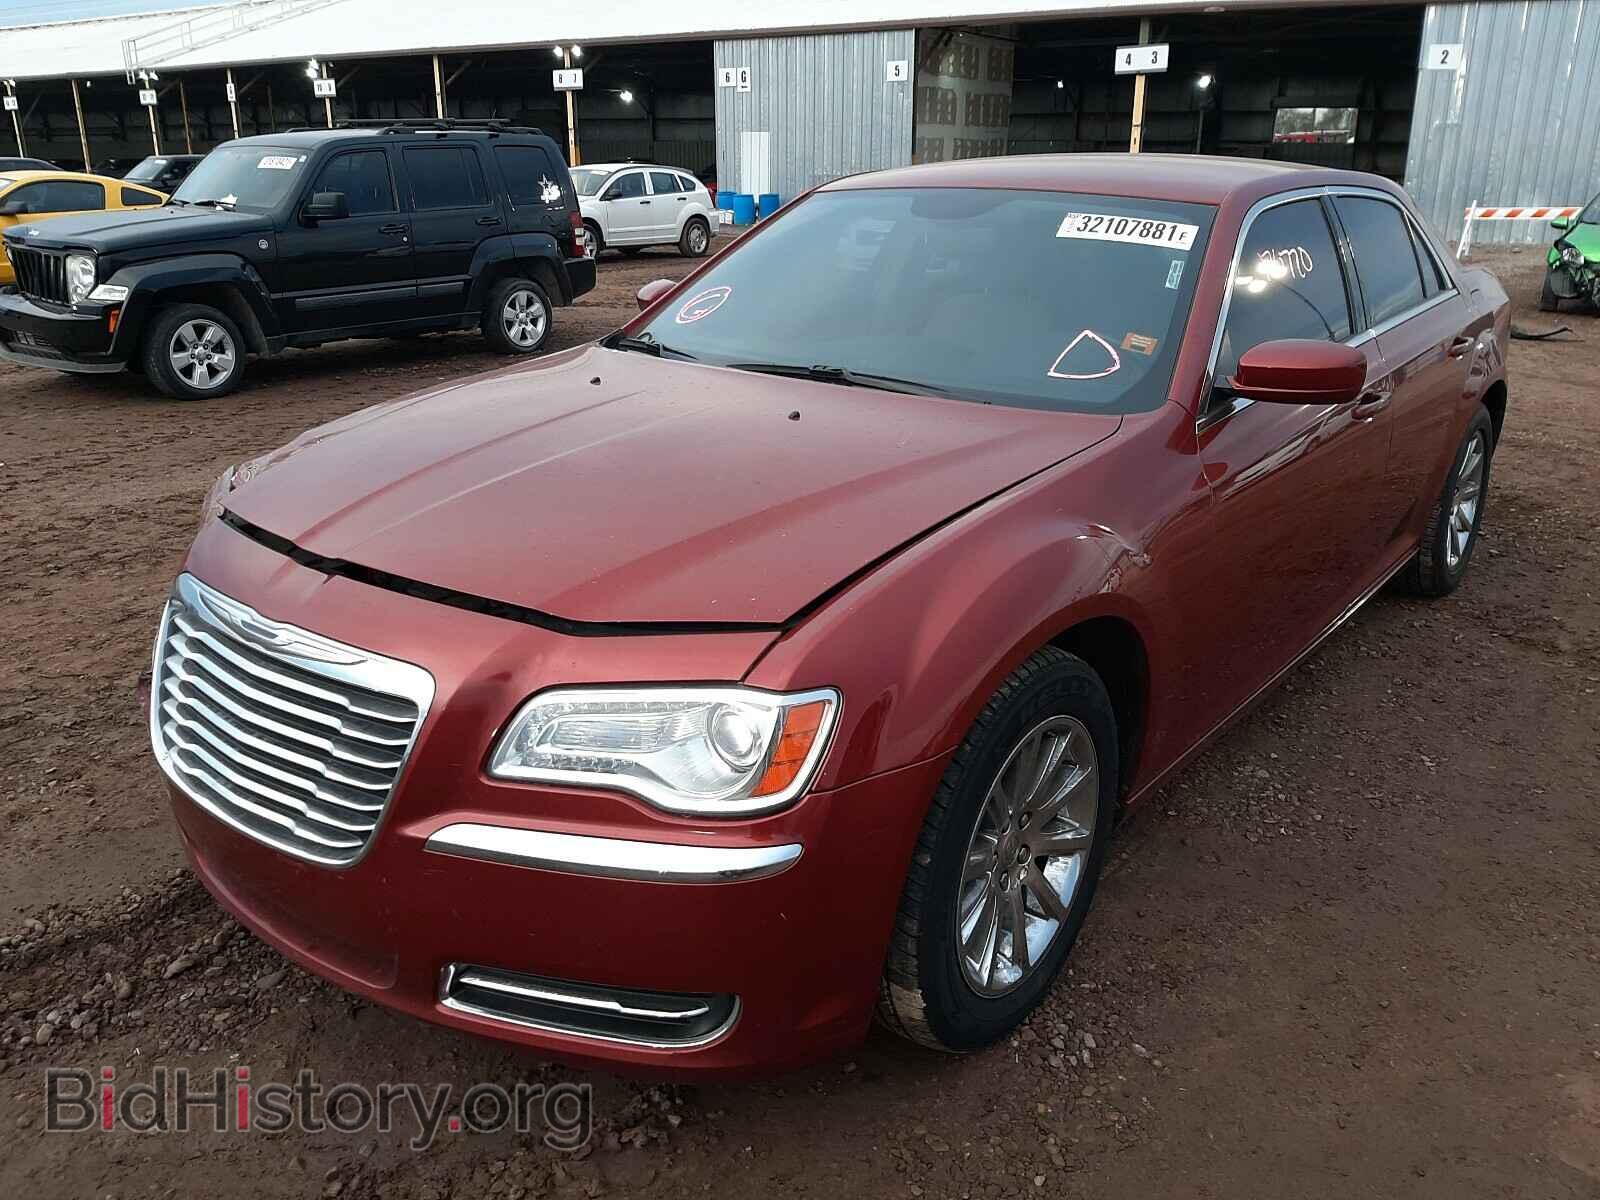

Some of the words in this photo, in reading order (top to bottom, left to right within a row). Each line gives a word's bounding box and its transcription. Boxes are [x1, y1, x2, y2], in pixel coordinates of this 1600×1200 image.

[1125, 53, 1131, 66] 4
[1151, 50, 1158, 64] 3
[1440, 49, 1449, 64] 2
[741, 70, 747, 83] G
[894, 64, 900, 77] 5
[1077, 215, 1178, 242] 32107881
